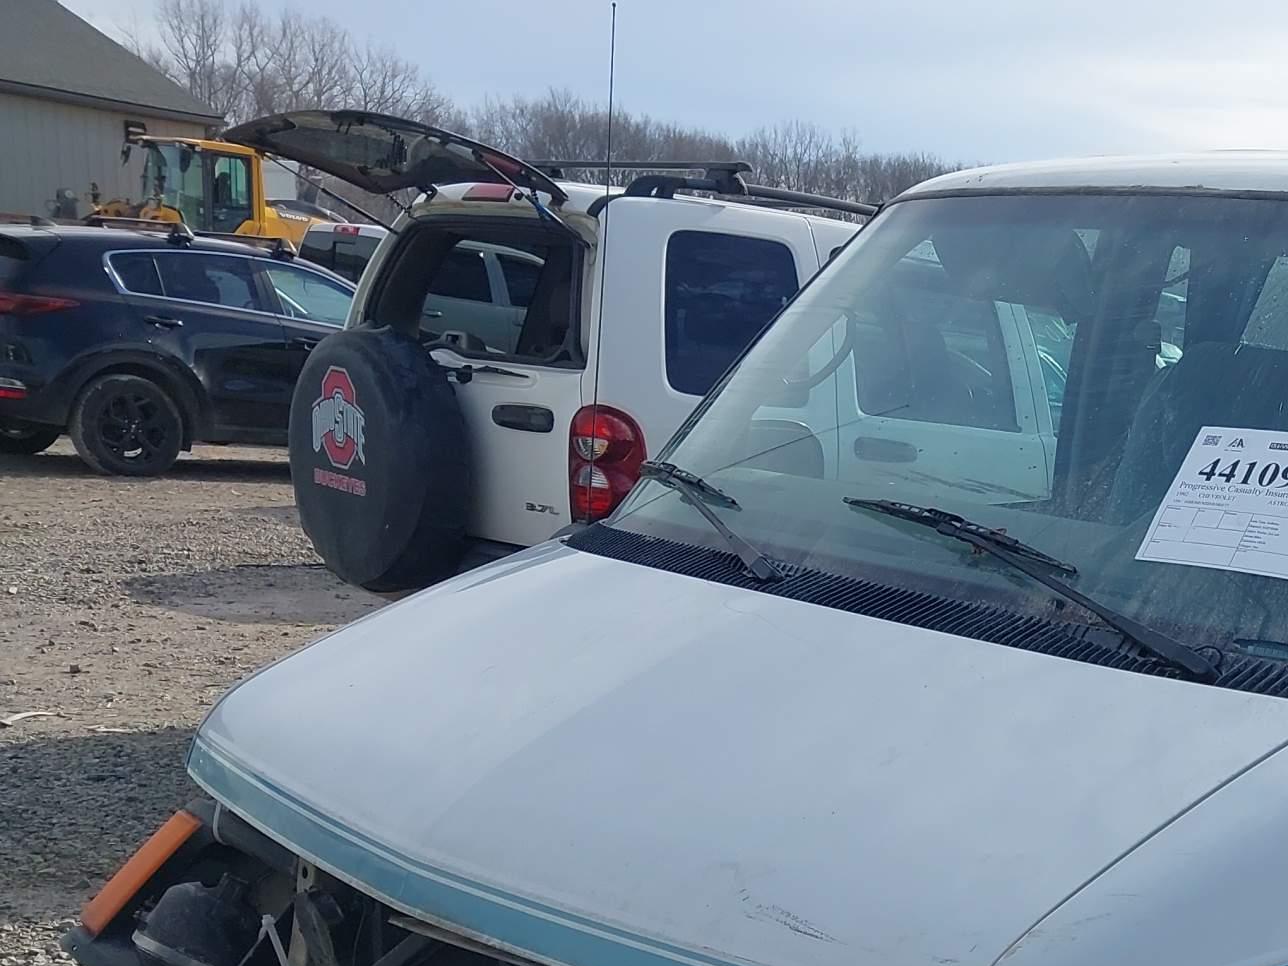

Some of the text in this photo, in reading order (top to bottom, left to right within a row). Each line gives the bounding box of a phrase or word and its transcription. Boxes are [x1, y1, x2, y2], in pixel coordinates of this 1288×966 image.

[334, 392, 366, 465] STATE
[313, 467, 367, 497] BUCKEYES
[1179, 480, 1226, 492] Progressive
[1227, 484, 1264, 497] Casualty
[1198, 492, 1236, 501] CHEVROLET
